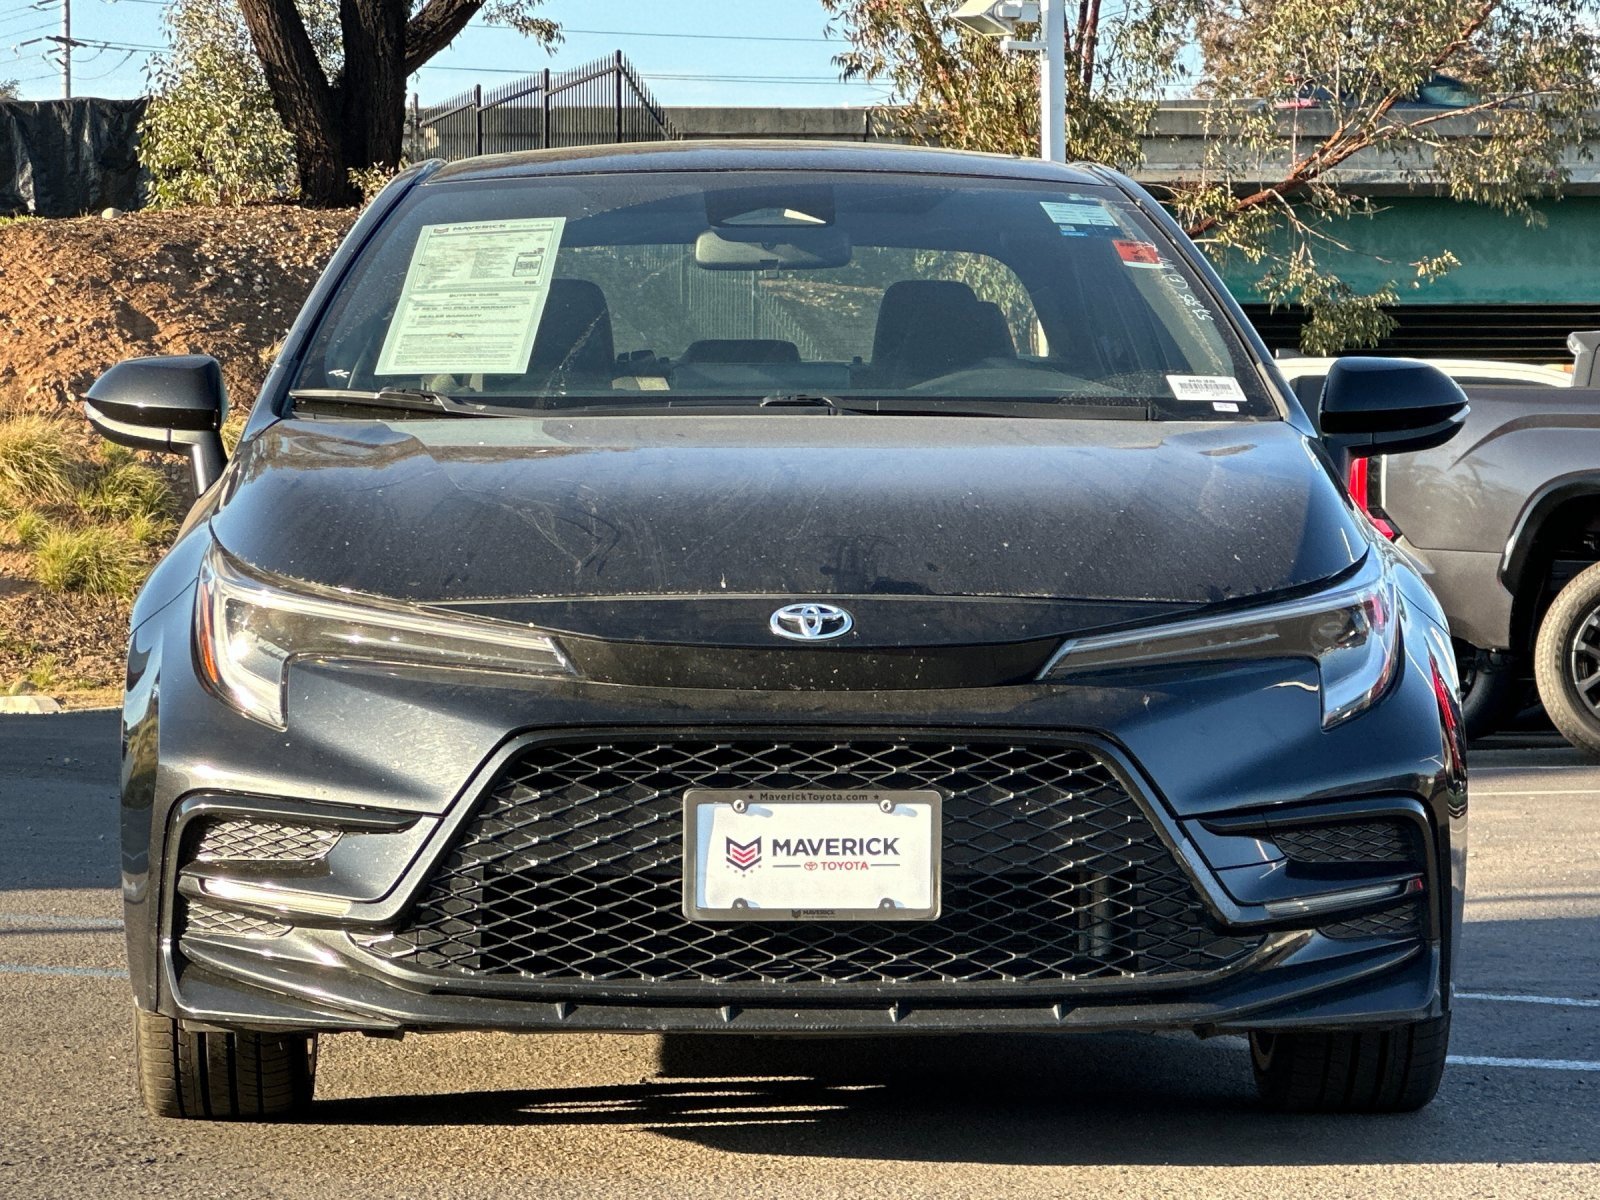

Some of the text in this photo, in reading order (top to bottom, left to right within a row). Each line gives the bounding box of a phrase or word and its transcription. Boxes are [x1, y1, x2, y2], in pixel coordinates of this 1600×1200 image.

[453, 223, 506, 232] MAVERICK
[760, 792, 868, 802] MaverickToyota.com
[772, 837, 900, 856] MAVERICK
[820, 861, 869, 871] TOYOTA
